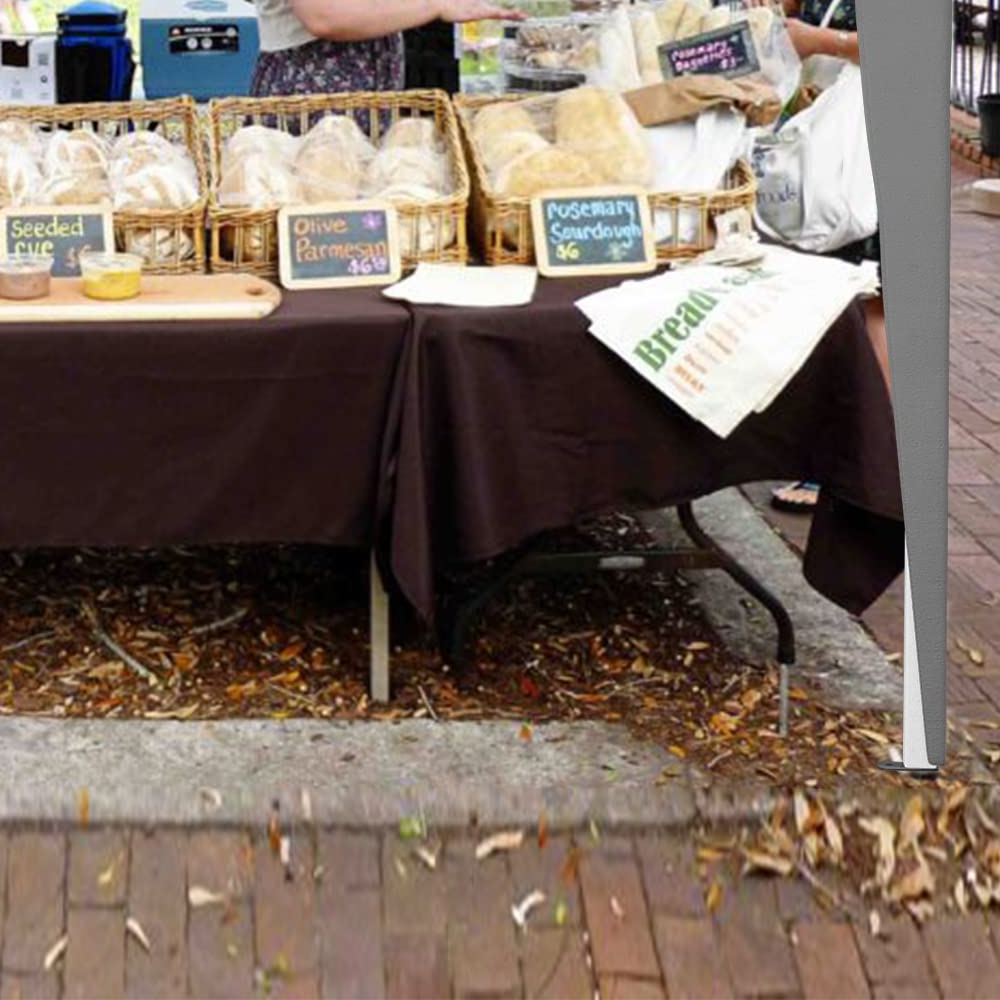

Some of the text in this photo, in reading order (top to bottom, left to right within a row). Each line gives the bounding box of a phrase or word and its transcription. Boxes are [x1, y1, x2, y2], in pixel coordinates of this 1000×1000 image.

[294, 217, 348, 236] Olive
[296, 237, 387, 262] Parmesan
[556, 242, 580, 260] $6
[633, 289, 718, 373] Bread
